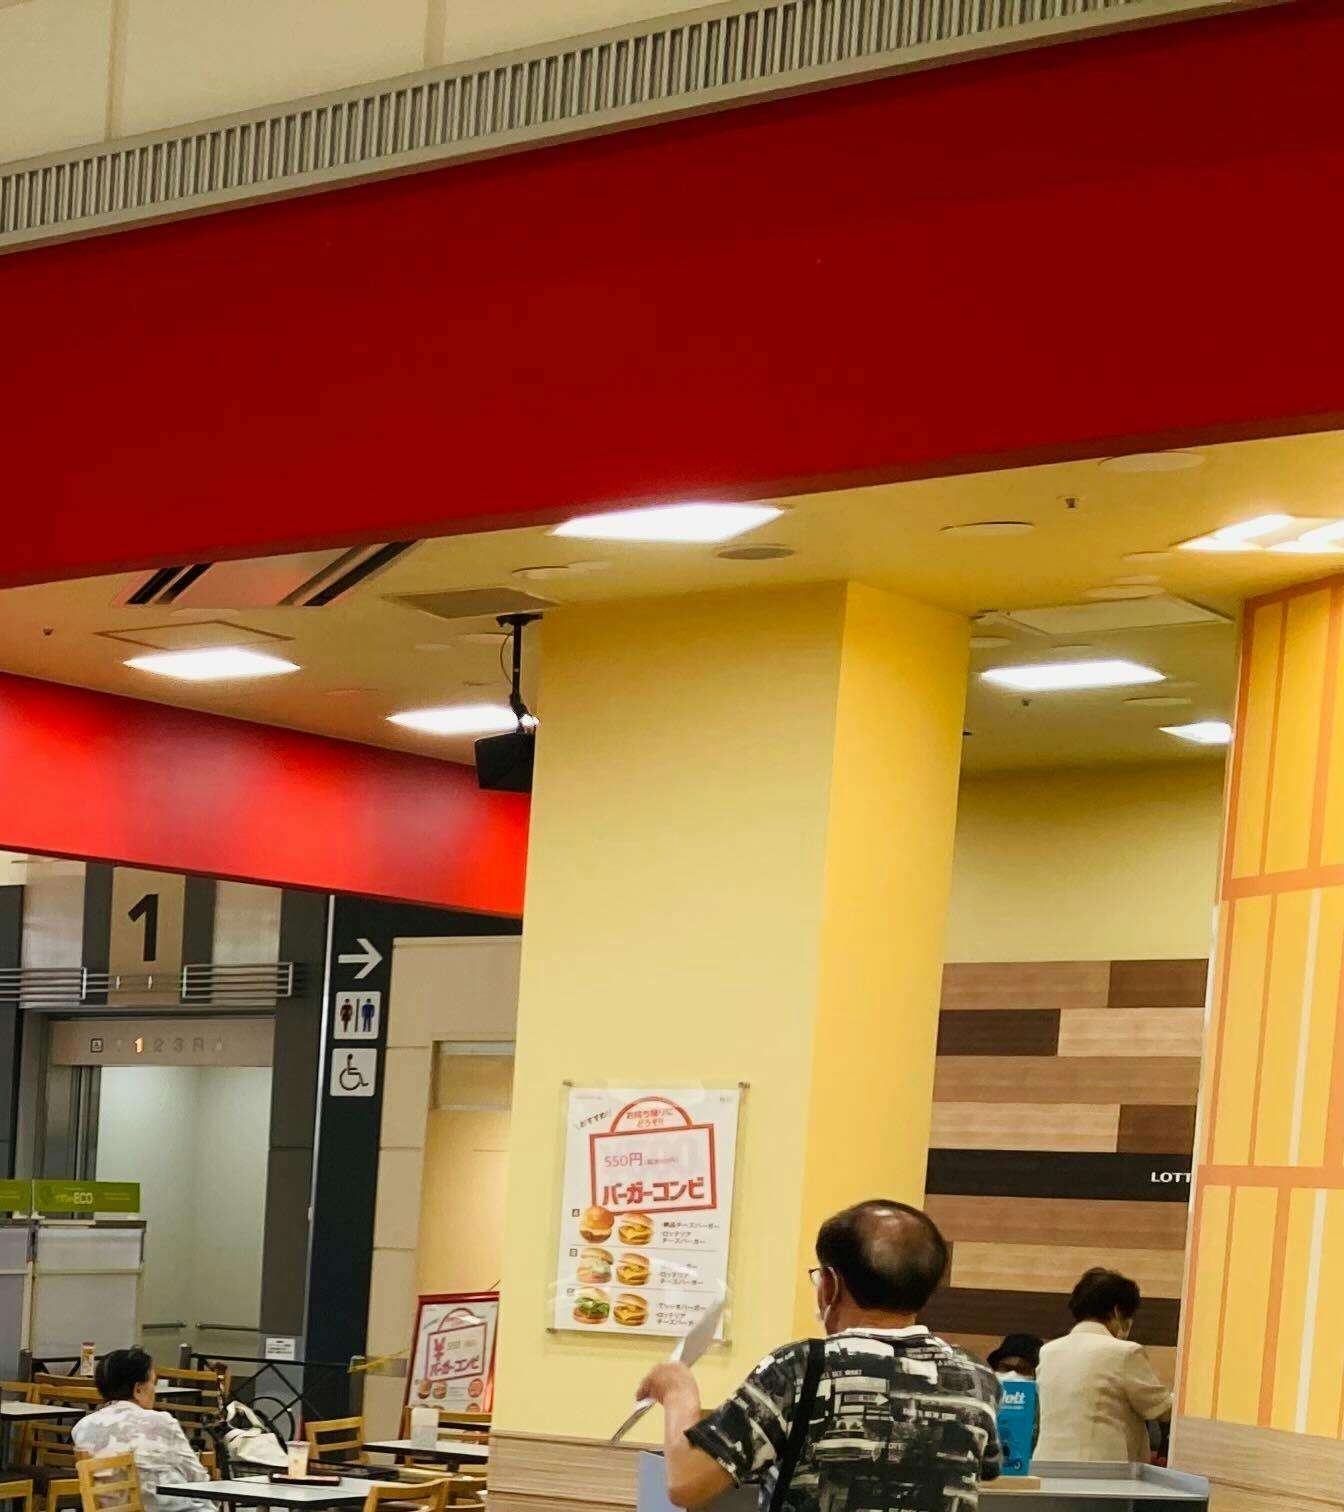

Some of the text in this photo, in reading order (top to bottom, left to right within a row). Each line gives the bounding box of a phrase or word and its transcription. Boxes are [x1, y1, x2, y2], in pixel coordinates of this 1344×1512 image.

[127, 893, 159, 961] 1
[604, 1151, 643, 1168] 550円
[602, 1176, 705, 1206] バーガーコンビ
